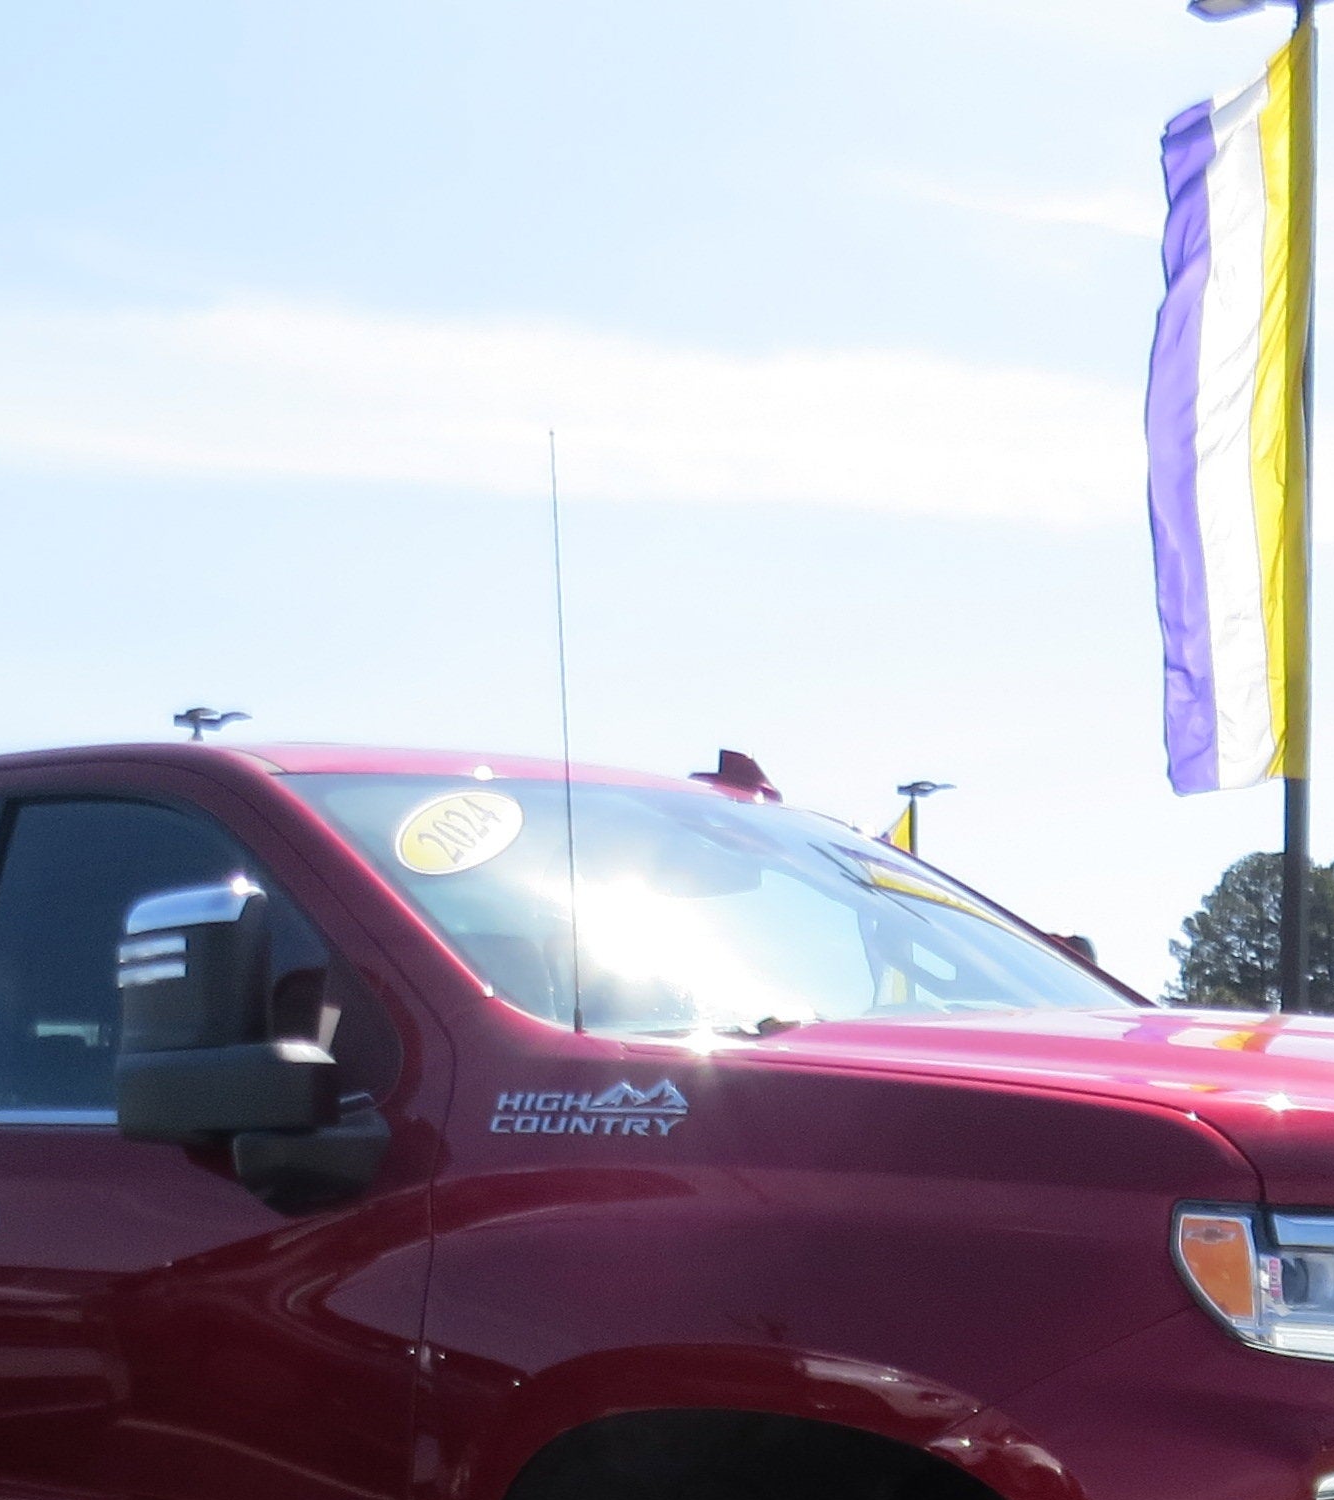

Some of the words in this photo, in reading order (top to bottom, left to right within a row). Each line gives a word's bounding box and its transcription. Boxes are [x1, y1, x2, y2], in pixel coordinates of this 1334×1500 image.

[417, 797, 501, 864] 2024
[496, 1092, 592, 1111] HIGH
[489, 1115, 685, 1136] COUNTRY
